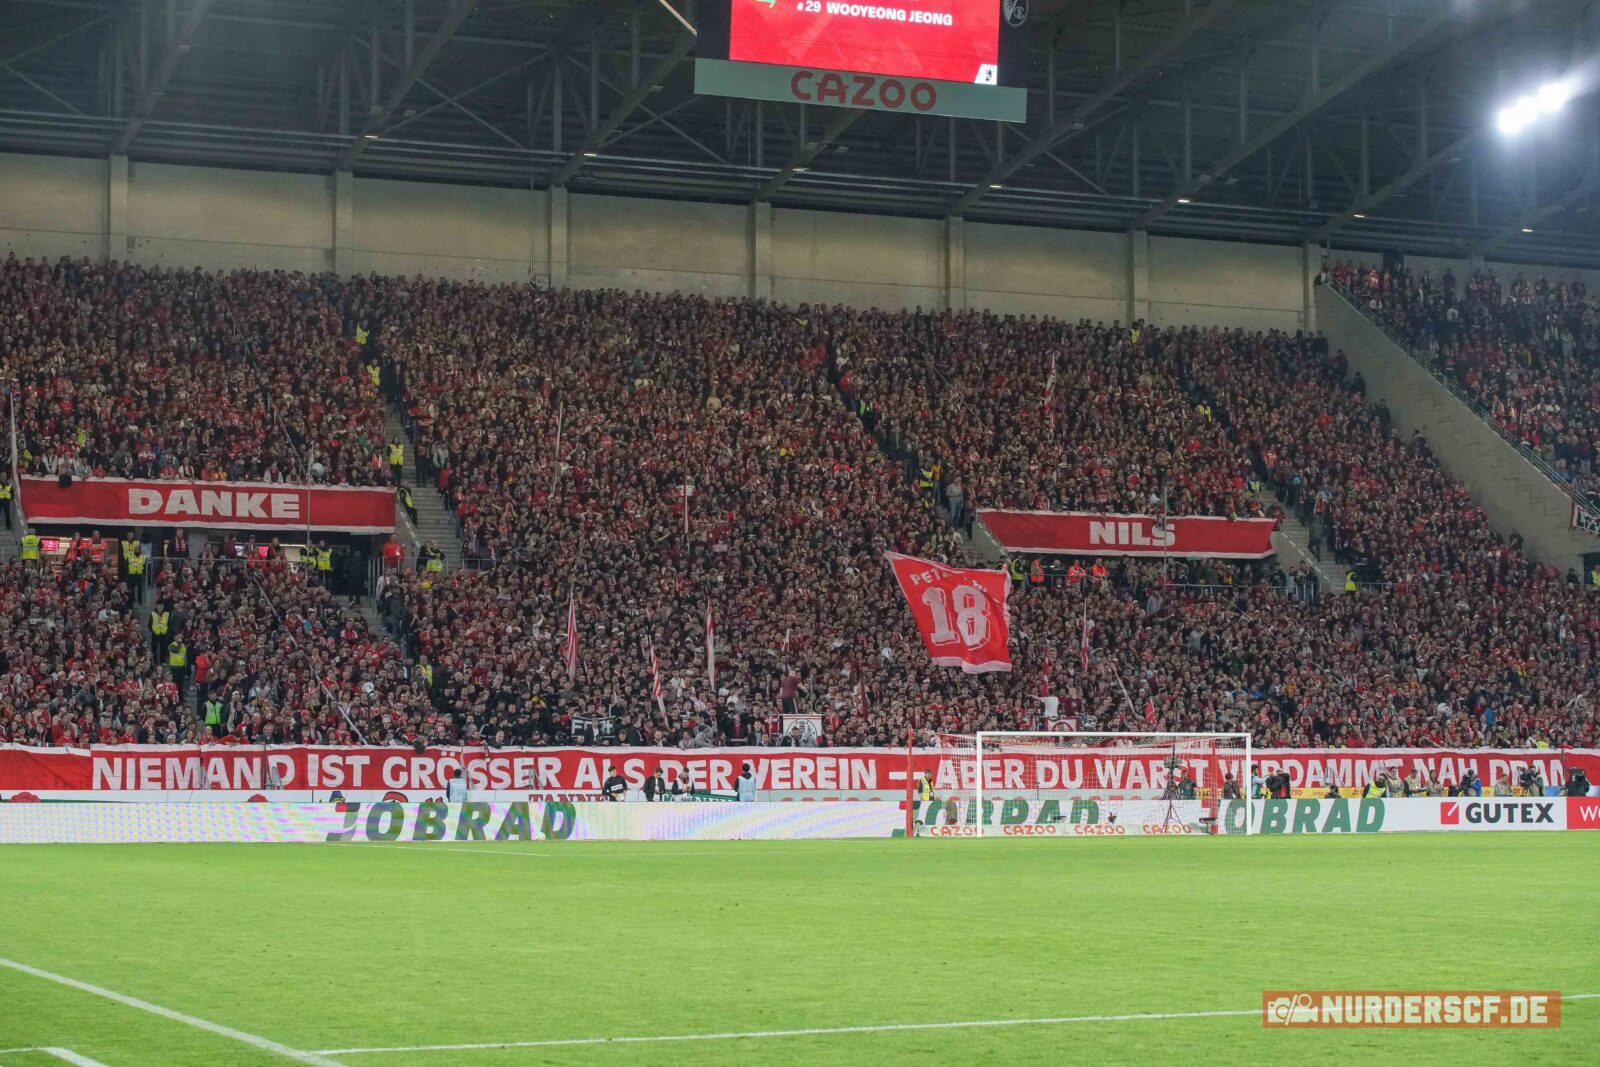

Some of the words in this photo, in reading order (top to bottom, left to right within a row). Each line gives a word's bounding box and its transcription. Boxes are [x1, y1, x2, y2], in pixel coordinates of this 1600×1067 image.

[826, 2, 906, 21] WOOYEONG
[908, 10, 953, 26] JEONG
[791, 71, 937, 111] CAZOO
[128, 488, 300, 519] DANKE
[1089, 520, 1175, 547] NILS
[922, 585, 989, 650] 18
[92, 755, 295, 790] NIEMAND
[307, 754, 370, 788] IST
[382, 751, 562, 790] GRÖSSER
[659, 759, 733, 790] DER
[742, 756, 878, 790] VEREIN
[935, 758, 1026, 789] ABER
[1035, 759, 1084, 789] DU
[1413, 757, 1478, 787] NAH
[326, 802, 577, 841] JOBRAD
[1465, 802, 1554, 824] GUTEX
[1003, 825, 1056, 835] CAZOO
[1075, 824, 1126, 835] CAZOO
[1143, 824, 1192, 834] CAZOO
